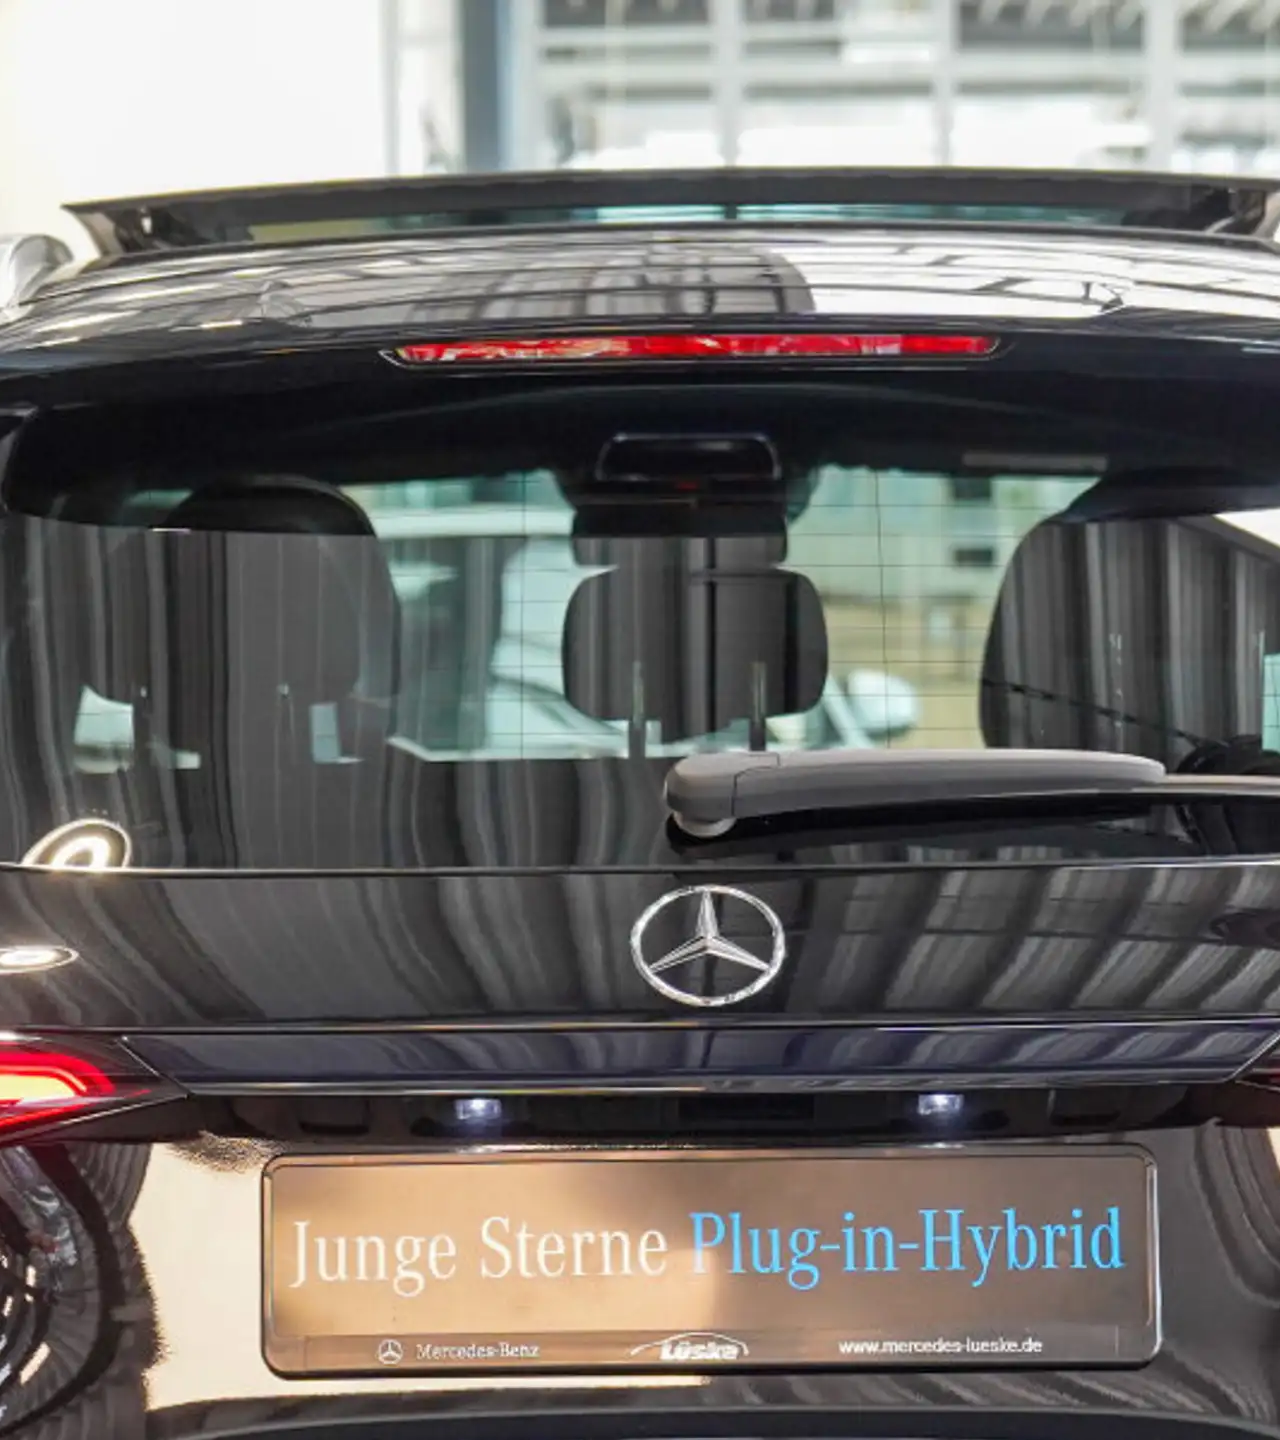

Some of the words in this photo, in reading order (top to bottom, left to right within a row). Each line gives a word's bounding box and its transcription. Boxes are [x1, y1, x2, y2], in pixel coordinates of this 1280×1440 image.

[289, 1220, 457, 1298] Junge
[479, 1216, 668, 1279] Sterne
[688, 1206, 1126, 1291] Plug-in-Hybrid
[415, 1341, 541, 1360] Mercedes-Benz
[659, 1340, 740, 1361] Lüske
[837, 1336, 1043, 1354] www.mercedes-lueske.de
